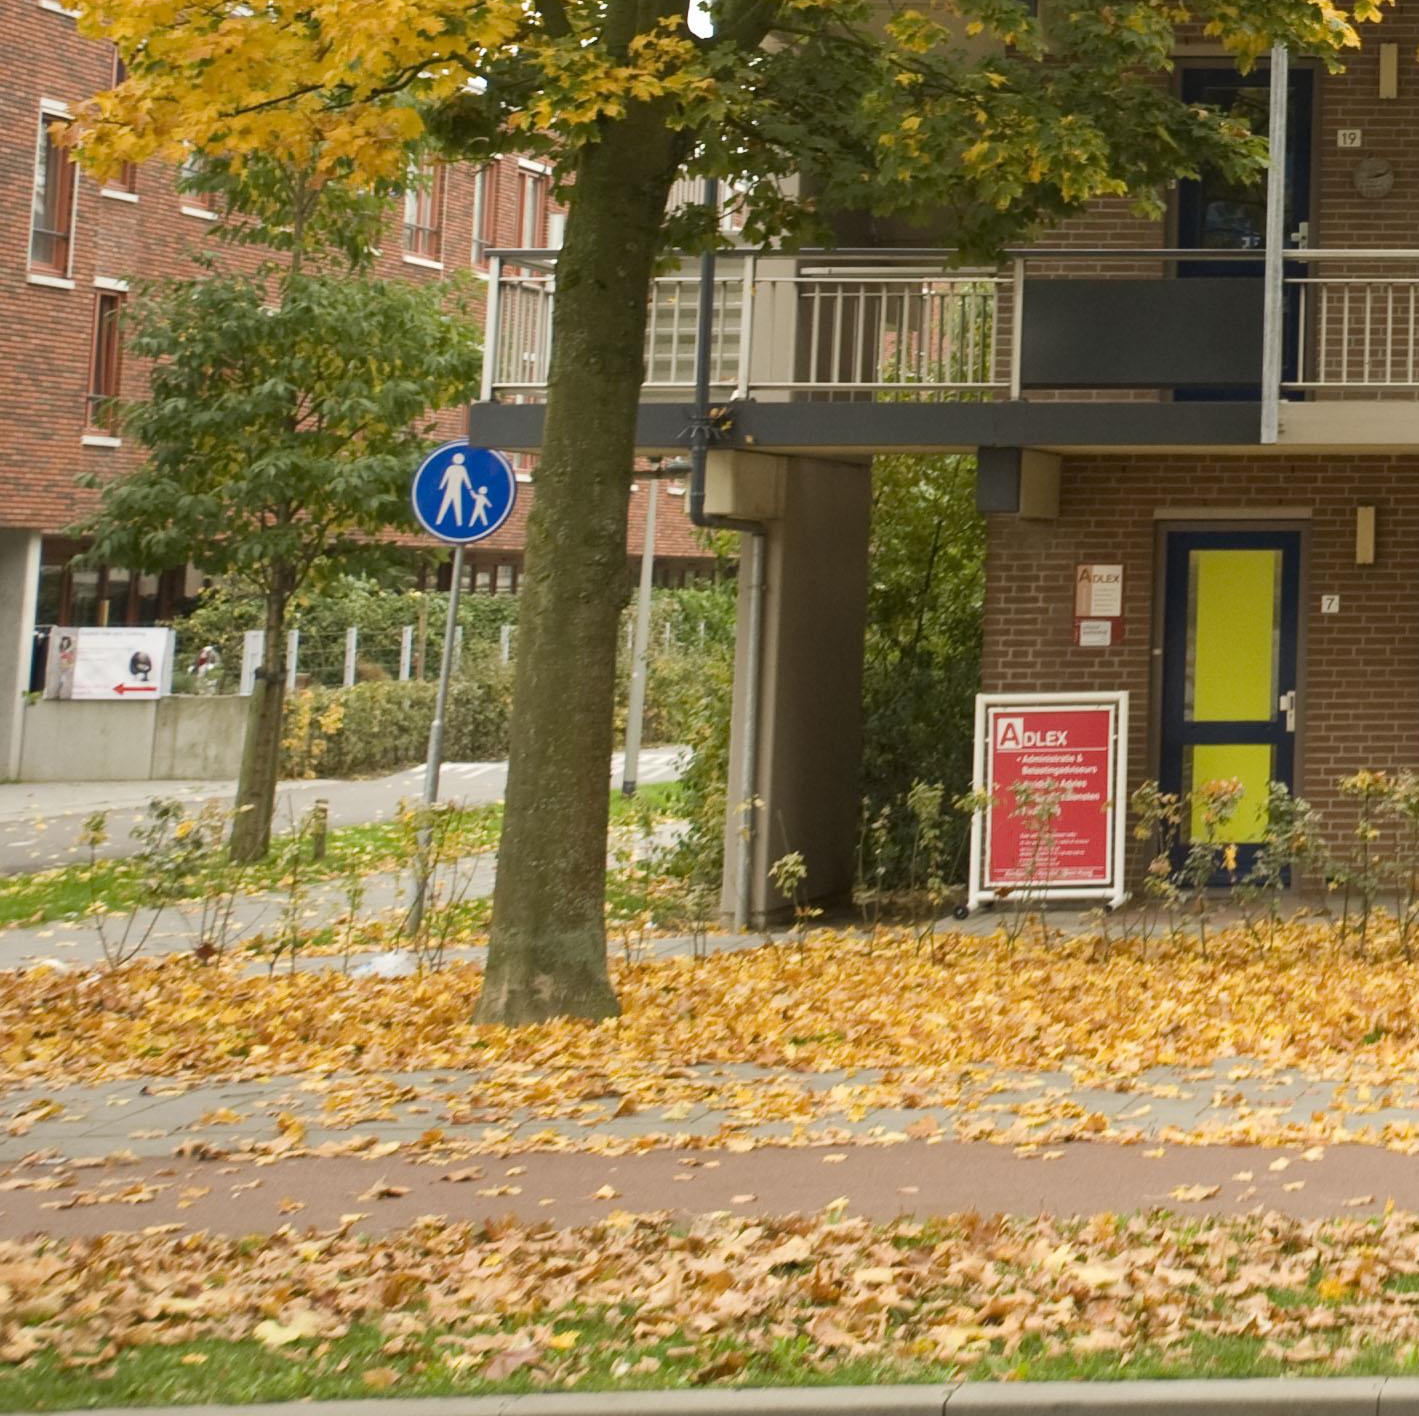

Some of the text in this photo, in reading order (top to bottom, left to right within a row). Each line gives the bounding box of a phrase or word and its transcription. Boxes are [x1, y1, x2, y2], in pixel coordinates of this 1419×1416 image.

[1341, 132, 1356, 145] 19
[1078, 568, 1120, 584] ADLEX
[1326, 597, 1335, 610] 7
[1000, 722, 1069, 747] ADLEX
